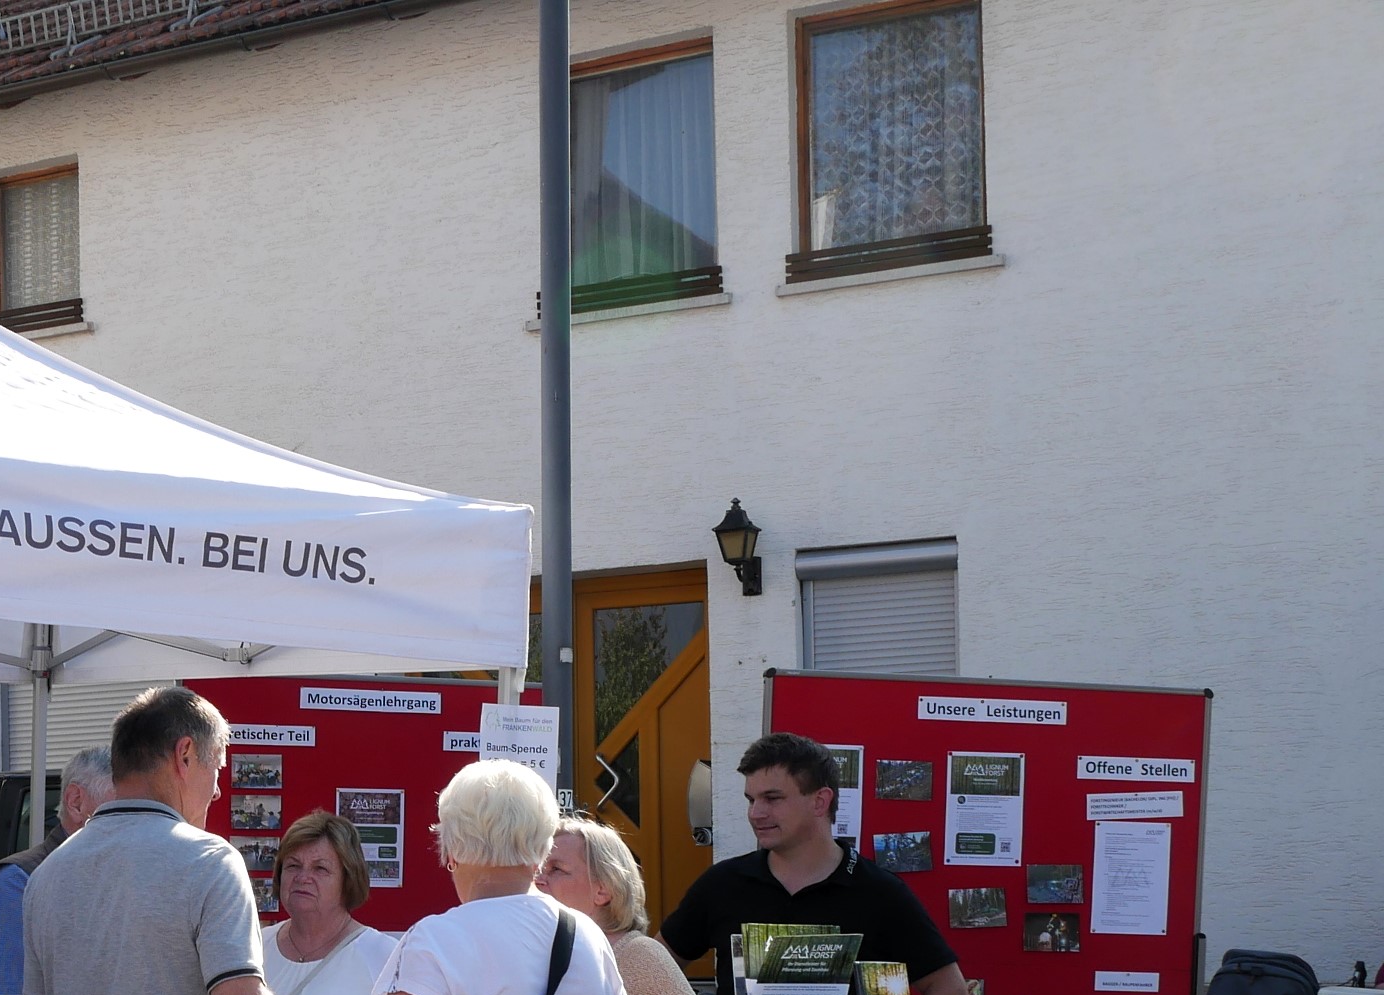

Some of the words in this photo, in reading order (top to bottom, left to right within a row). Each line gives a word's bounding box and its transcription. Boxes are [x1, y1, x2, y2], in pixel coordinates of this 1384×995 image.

[202, 531, 268, 573] BEI
[282, 539, 376, 585] UNS.
[306, 692, 437, 711] Motorsägenlehrgang
[926, 702, 976, 717] Unsere
[986, 705, 1061, 722] Leistungen
[228, 727, 285, 741] retischer
[288, 730, 310, 742] Teil
[502, 723, 553, 733] FRANKENWALD
[486, 742, 548, 755] Baum-Spende
[530, 759, 536, 769] 5
[539, 759, 546, 769] €
[1085, 760, 1133, 776] Offene
[1140, 763, 1188, 778] Stellen
[811, 943, 843, 952] LIGNUM
[809, 951, 836, 959] FORST
